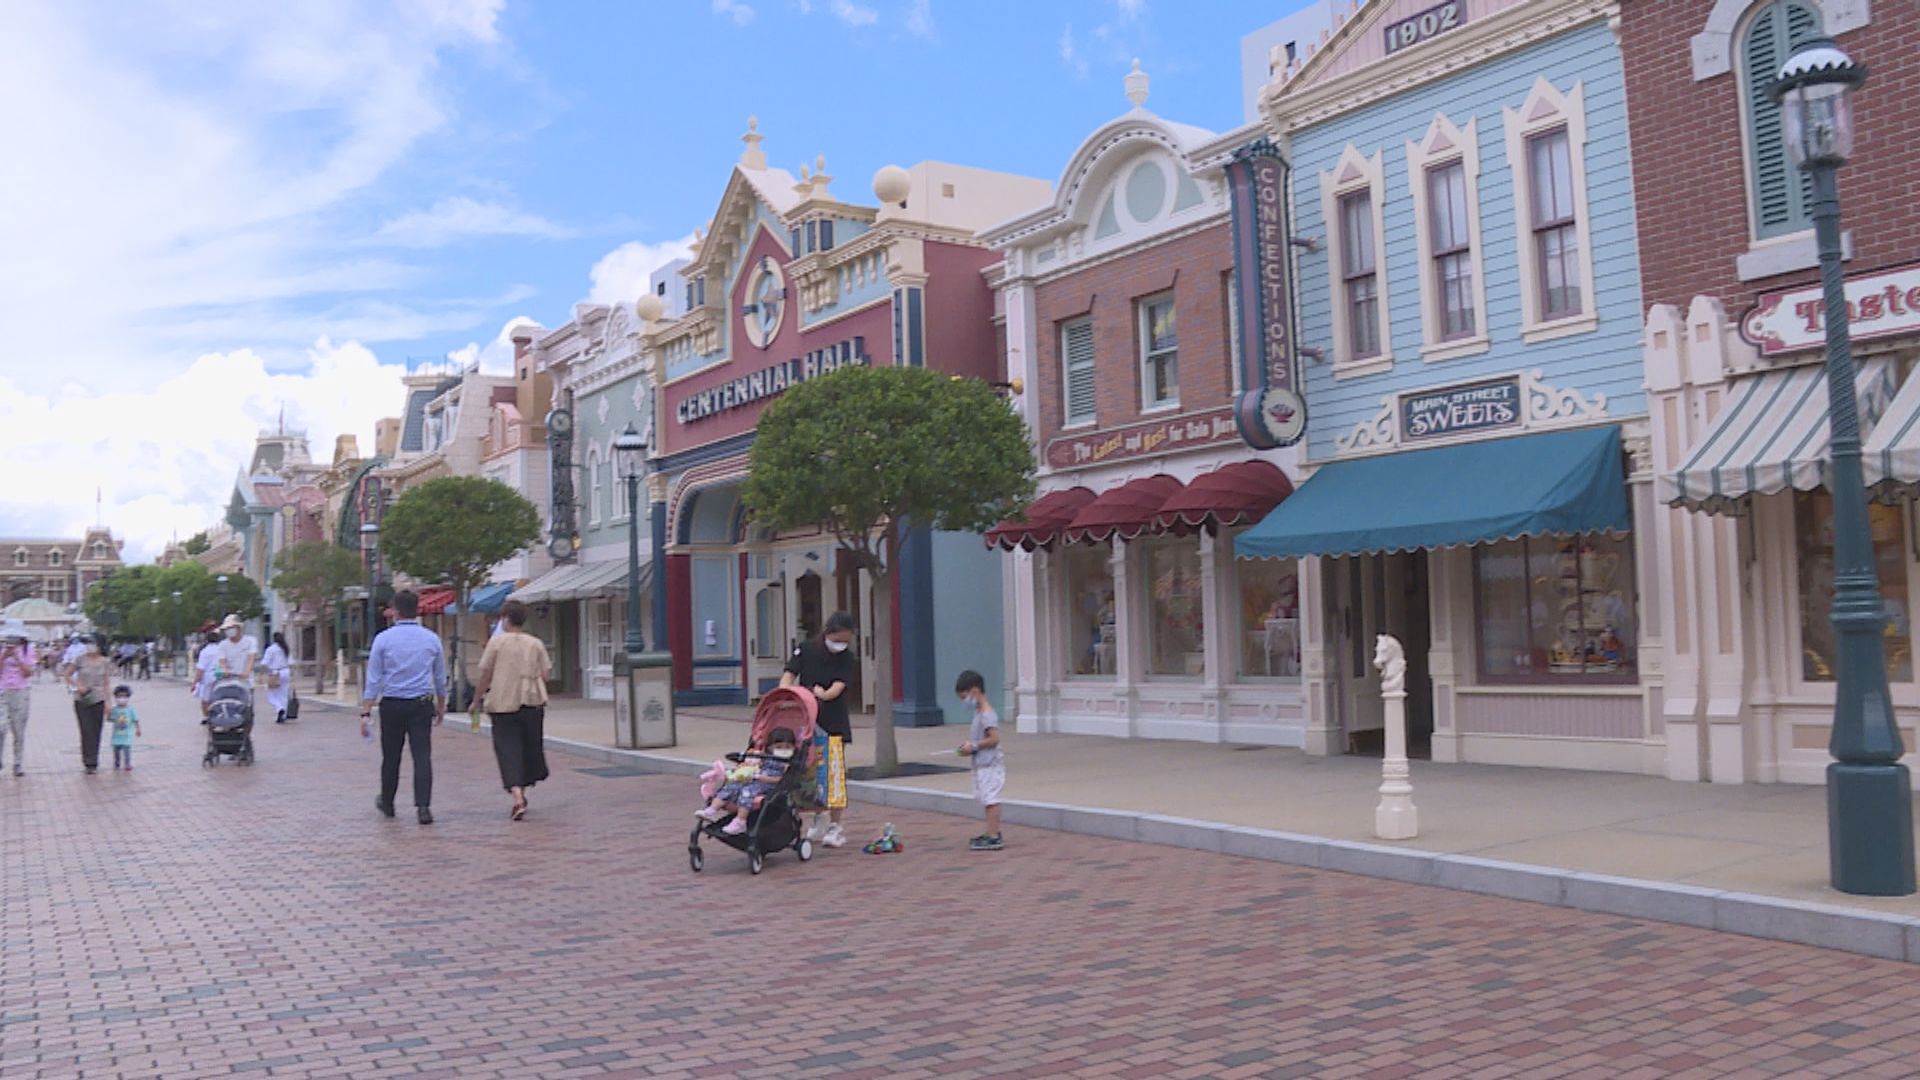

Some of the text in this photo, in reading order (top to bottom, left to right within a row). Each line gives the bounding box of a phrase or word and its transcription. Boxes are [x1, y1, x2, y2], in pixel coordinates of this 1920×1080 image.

[1388, 4, 1458, 50] 1902
[1260, 167, 1287, 380] CONFECTIONS
[677, 336, 868, 424] CENTENNIAL HALL
[1411, 386, 1511, 412] MAIN STREET
[1410, 402, 1514, 435] SWEETS
[1074, 442, 1091, 463] The
